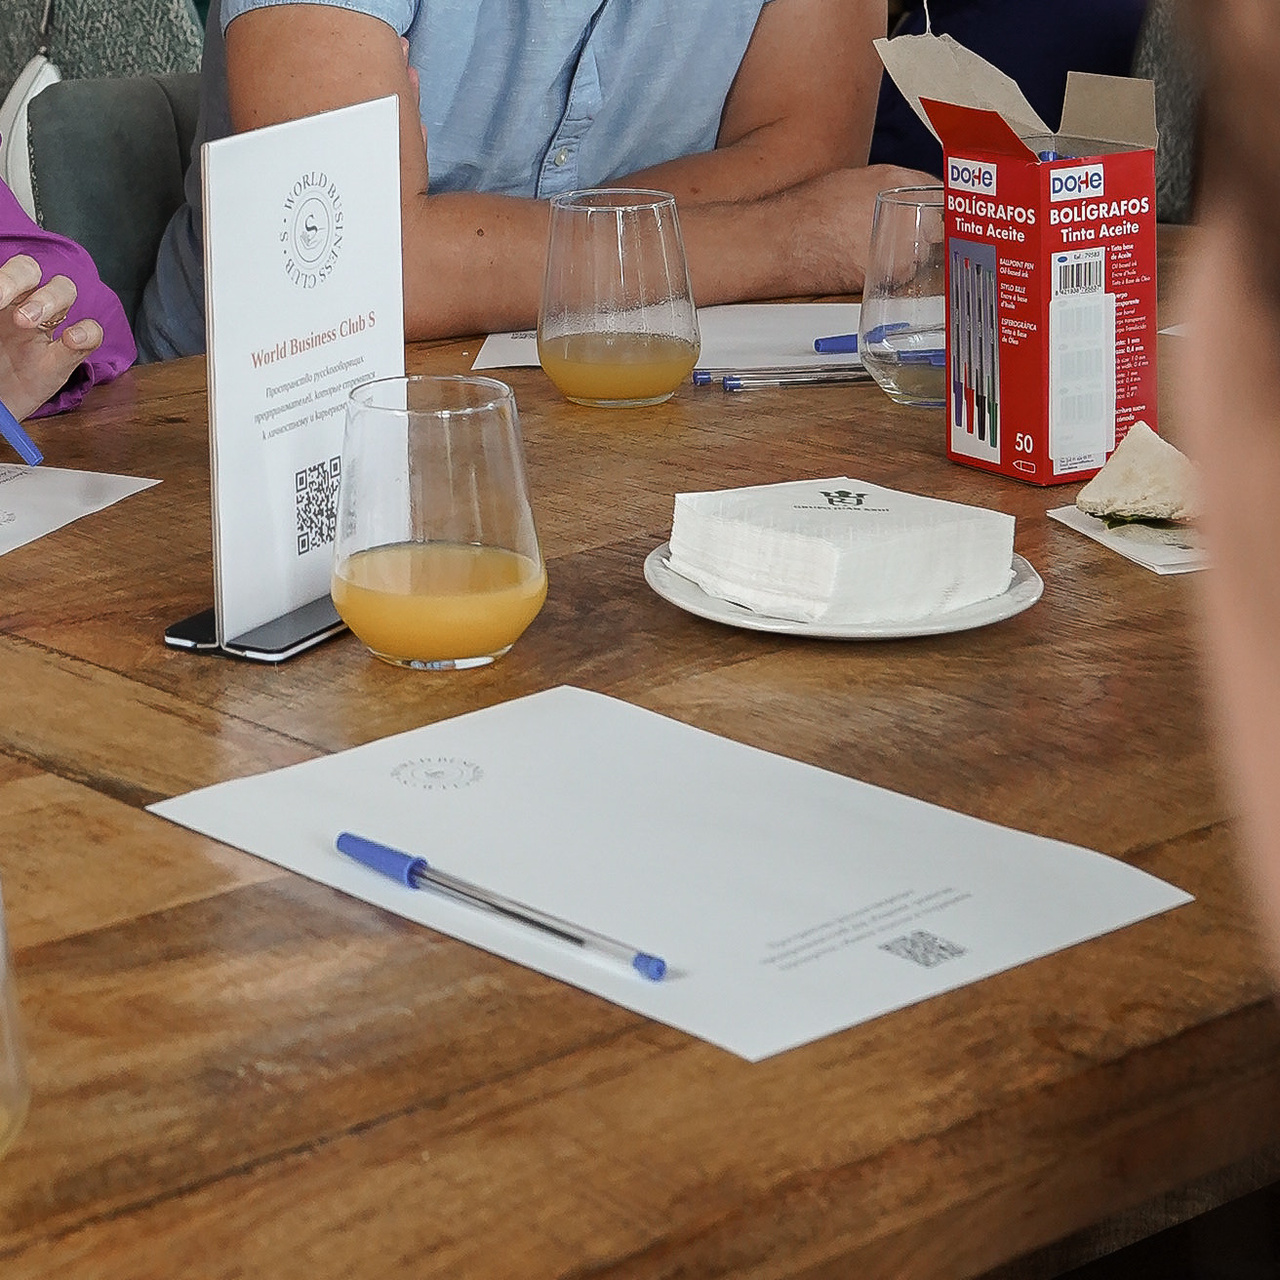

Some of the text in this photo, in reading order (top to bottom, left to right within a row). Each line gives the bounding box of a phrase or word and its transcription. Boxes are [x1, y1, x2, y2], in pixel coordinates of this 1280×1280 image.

[284, 171, 328, 210] WORLD
[948, 195, 1036, 225] BOLÍGRAFOS
[1050, 197, 1150, 225] BOLÍGRAFOS
[319, 183, 344, 283] BUSINESS
[955, 217, 1025, 243] Tinta Aceite
[1061, 221, 1140, 243] Tinta Aceite
[285, 259, 317, 289] CLUB
[250, 311, 376, 369] World Business Club S
[1015, 432, 1033, 454] 50
